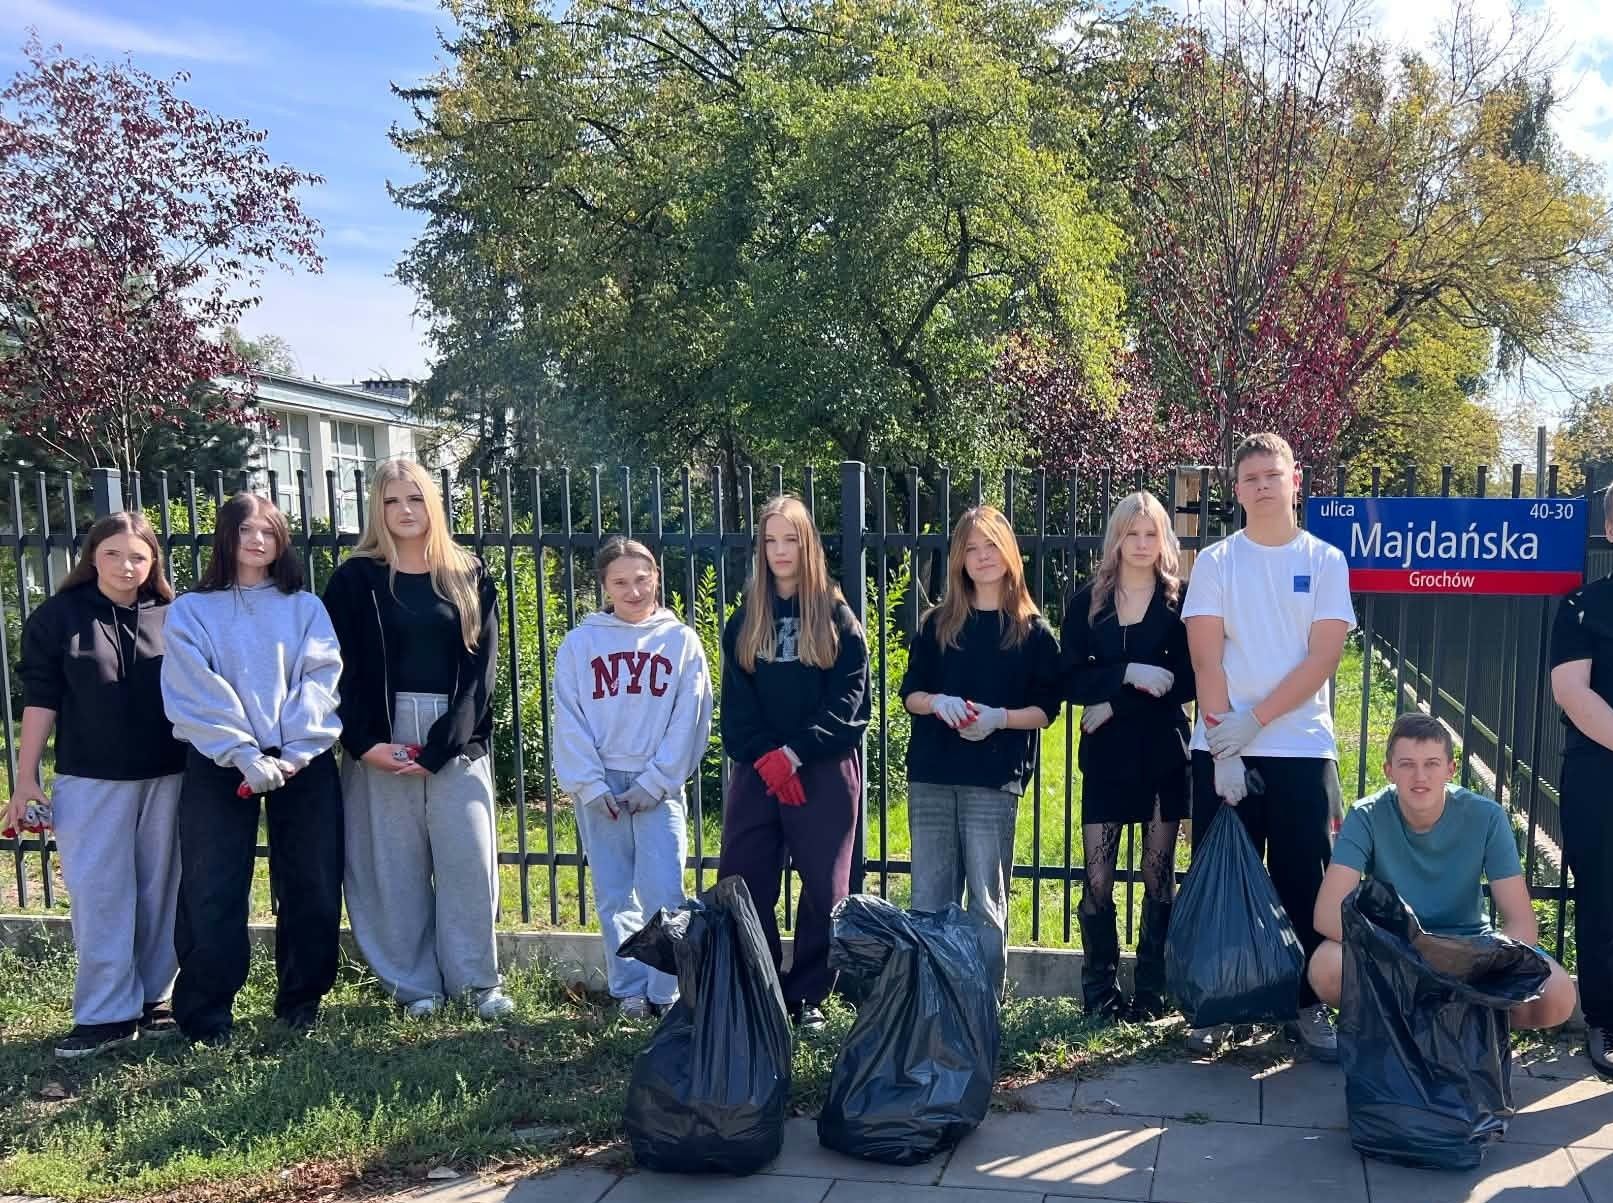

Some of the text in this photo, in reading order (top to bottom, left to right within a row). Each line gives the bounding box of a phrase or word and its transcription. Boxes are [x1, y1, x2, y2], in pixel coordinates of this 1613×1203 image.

[1320, 502, 1574, 520] ulica 40-30
[1350, 521, 1538, 568] Majdańska
[1408, 571, 1475, 588] Grochów
[590, 651, 673, 700] NYC
